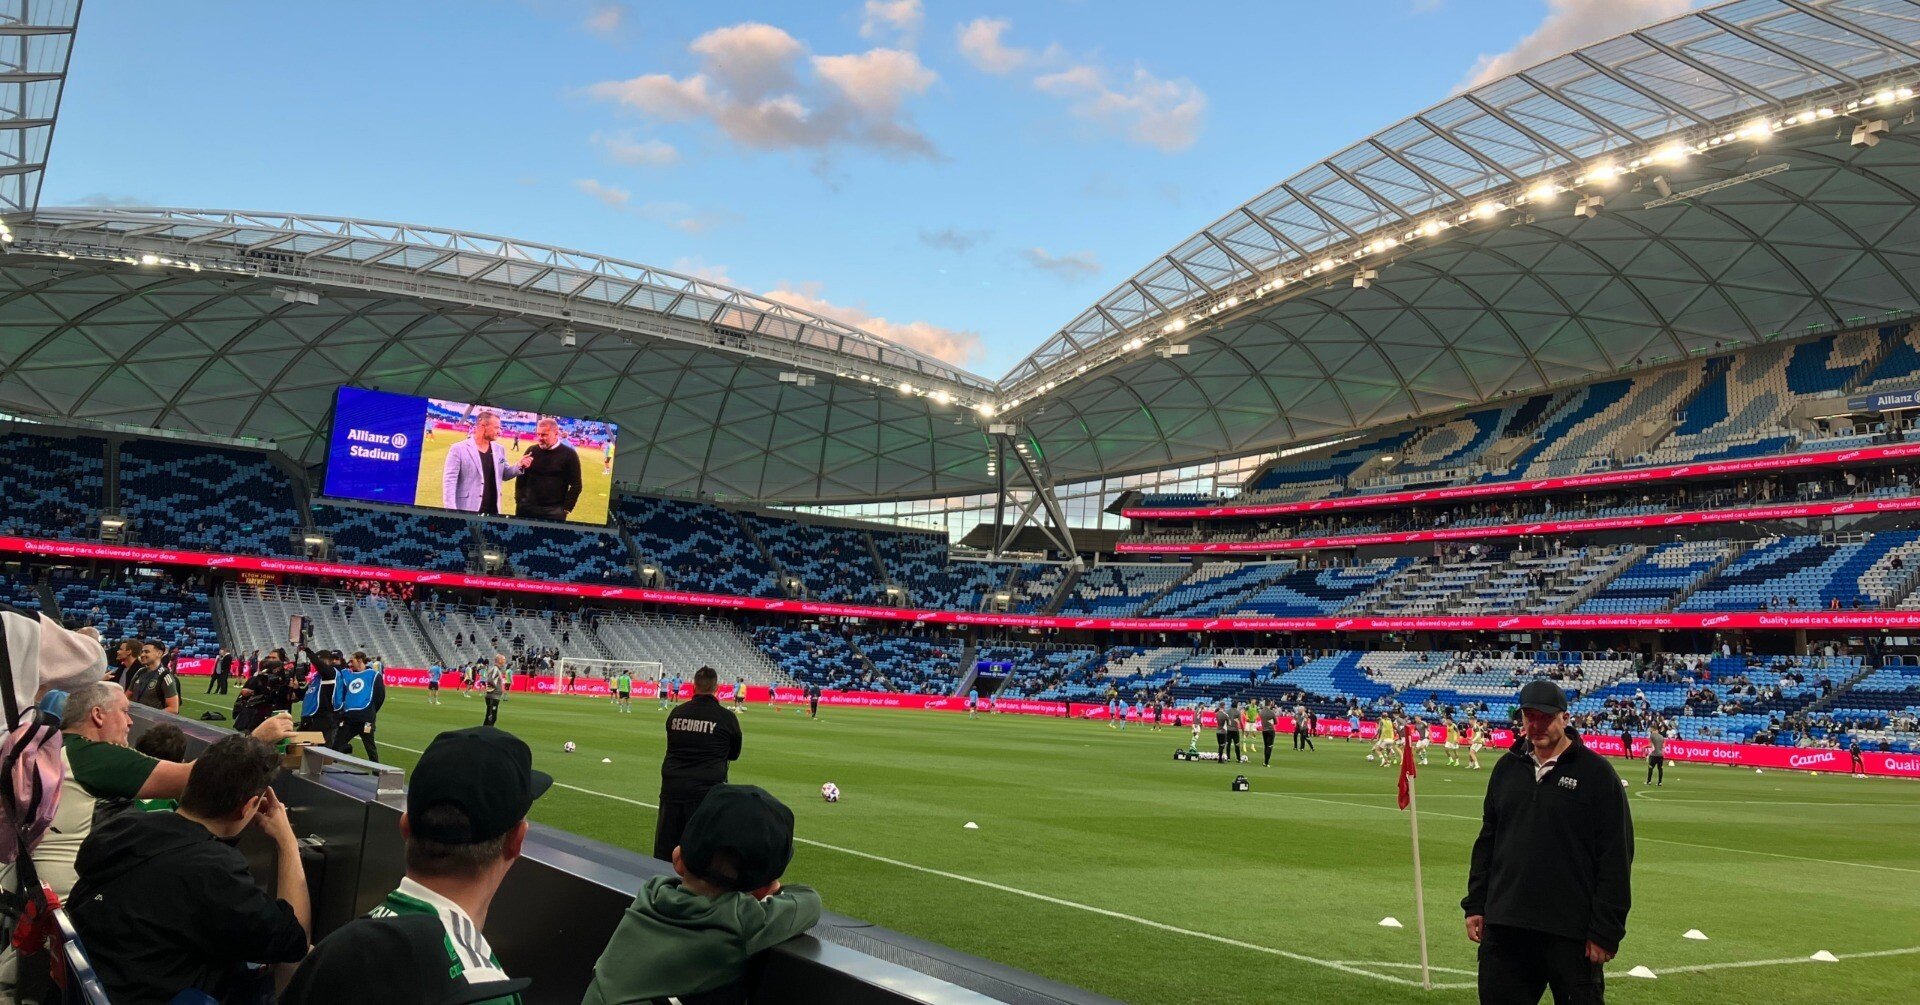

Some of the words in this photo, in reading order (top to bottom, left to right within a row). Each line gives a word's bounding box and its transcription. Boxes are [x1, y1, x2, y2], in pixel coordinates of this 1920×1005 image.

[1878, 395, 1912, 405] Allianz
[348, 429, 390, 444] Allianz
[350, 446, 399, 461] Stadium
[25, 542, 54, 552] Quality
[95, 548, 130, 556] delivered
[159, 551, 177, 560] door.
[207, 556, 235, 565] Carma
[261, 561, 286, 570] Quality
[321, 566, 351, 574] delivered
[464, 577, 486, 586] Quality
[1542, 618, 1565, 627] Quality
[1702, 615, 1730, 627] Carma
[1759, 616, 1789, 625] Quality
[1886, 617, 1905, 625] your
[388, 674, 396, 682] to
[398, 676, 417, 685] your
[831, 695, 861, 704] delivered
[924, 699, 948, 711] Carma
[672, 718, 717, 734] SECURITY
[1600, 742, 1623, 752] cars,
[1673, 745, 1684, 755] to
[1687, 748, 1710, 758] your
[1713, 747, 1742, 758] door.
[1790, 752, 1836, 768] Carma
[1559, 776, 1578, 786] ACES
